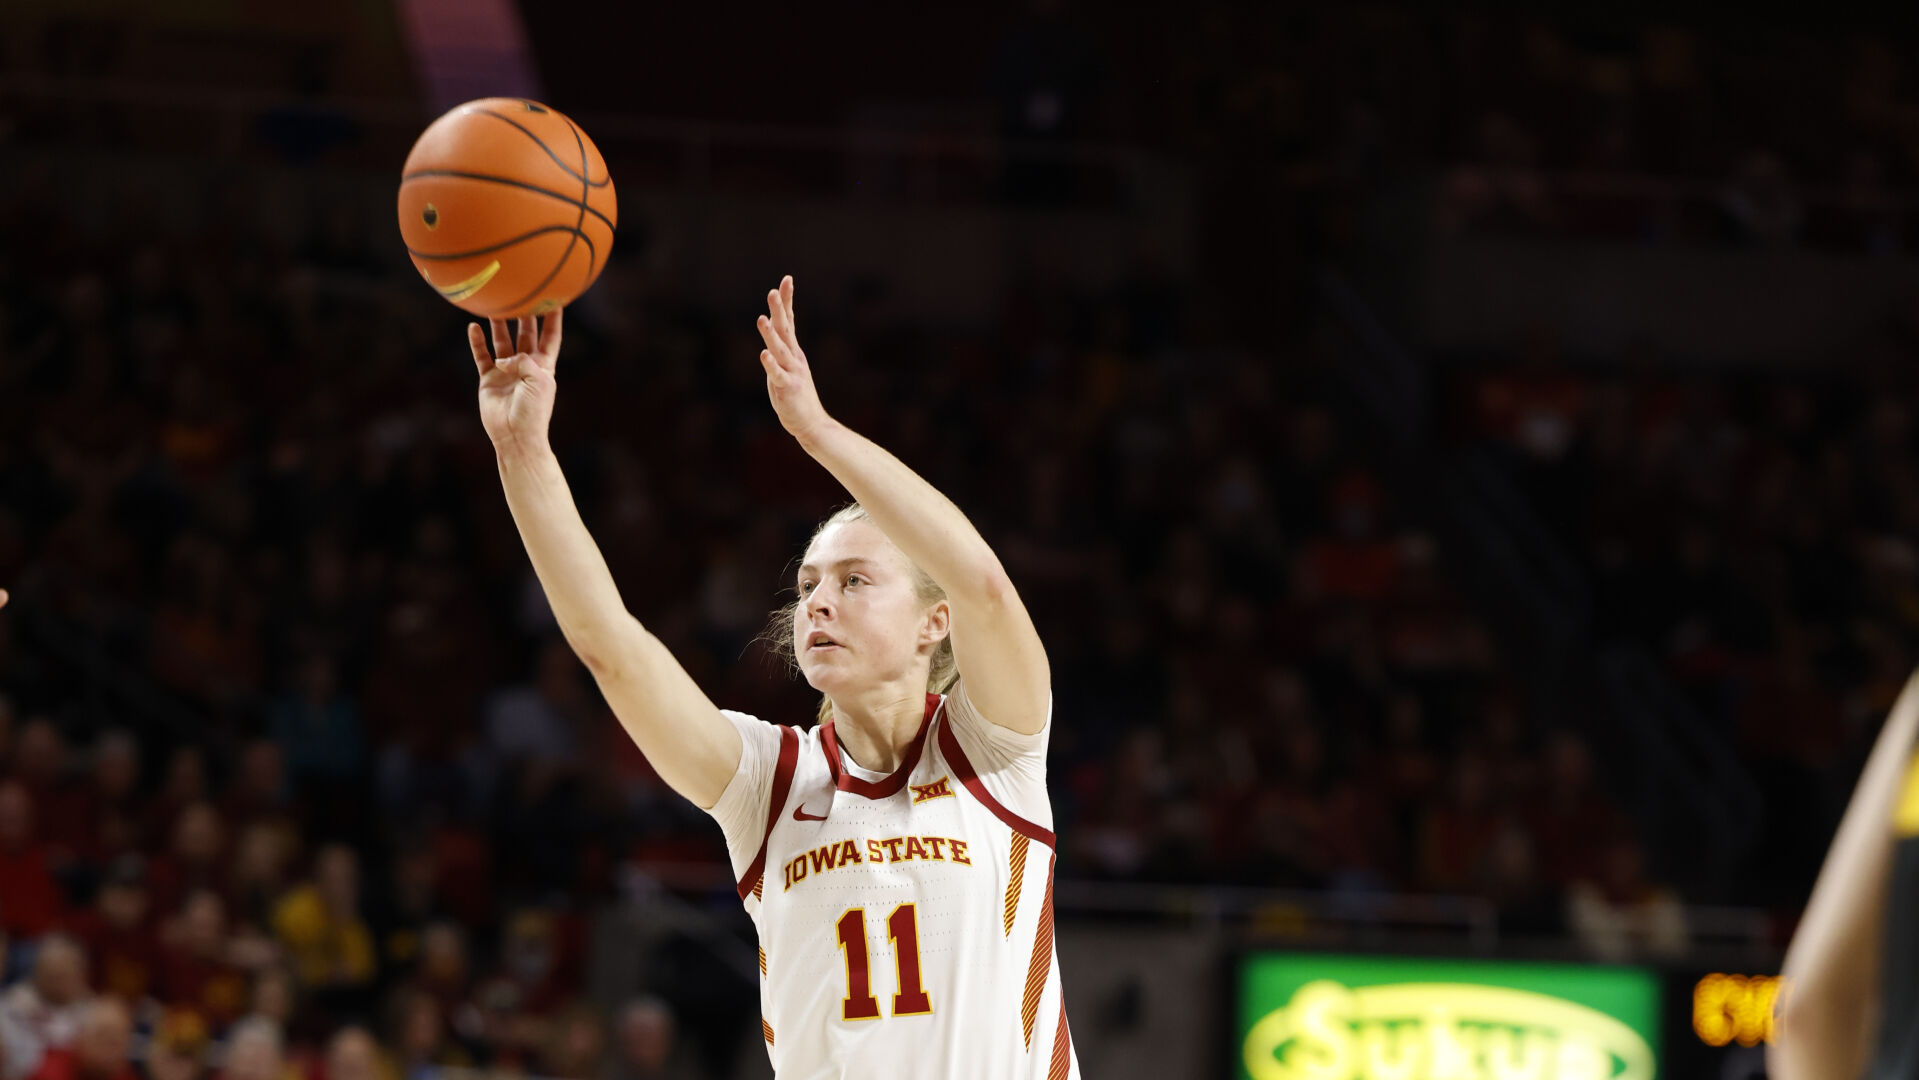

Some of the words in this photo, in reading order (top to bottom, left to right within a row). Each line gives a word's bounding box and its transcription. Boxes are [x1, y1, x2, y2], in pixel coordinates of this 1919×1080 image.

[909, 774, 956, 806] XII
[784, 839, 862, 893] IOWA
[867, 835, 972, 868] STATE
[835, 902, 933, 1021] 11
